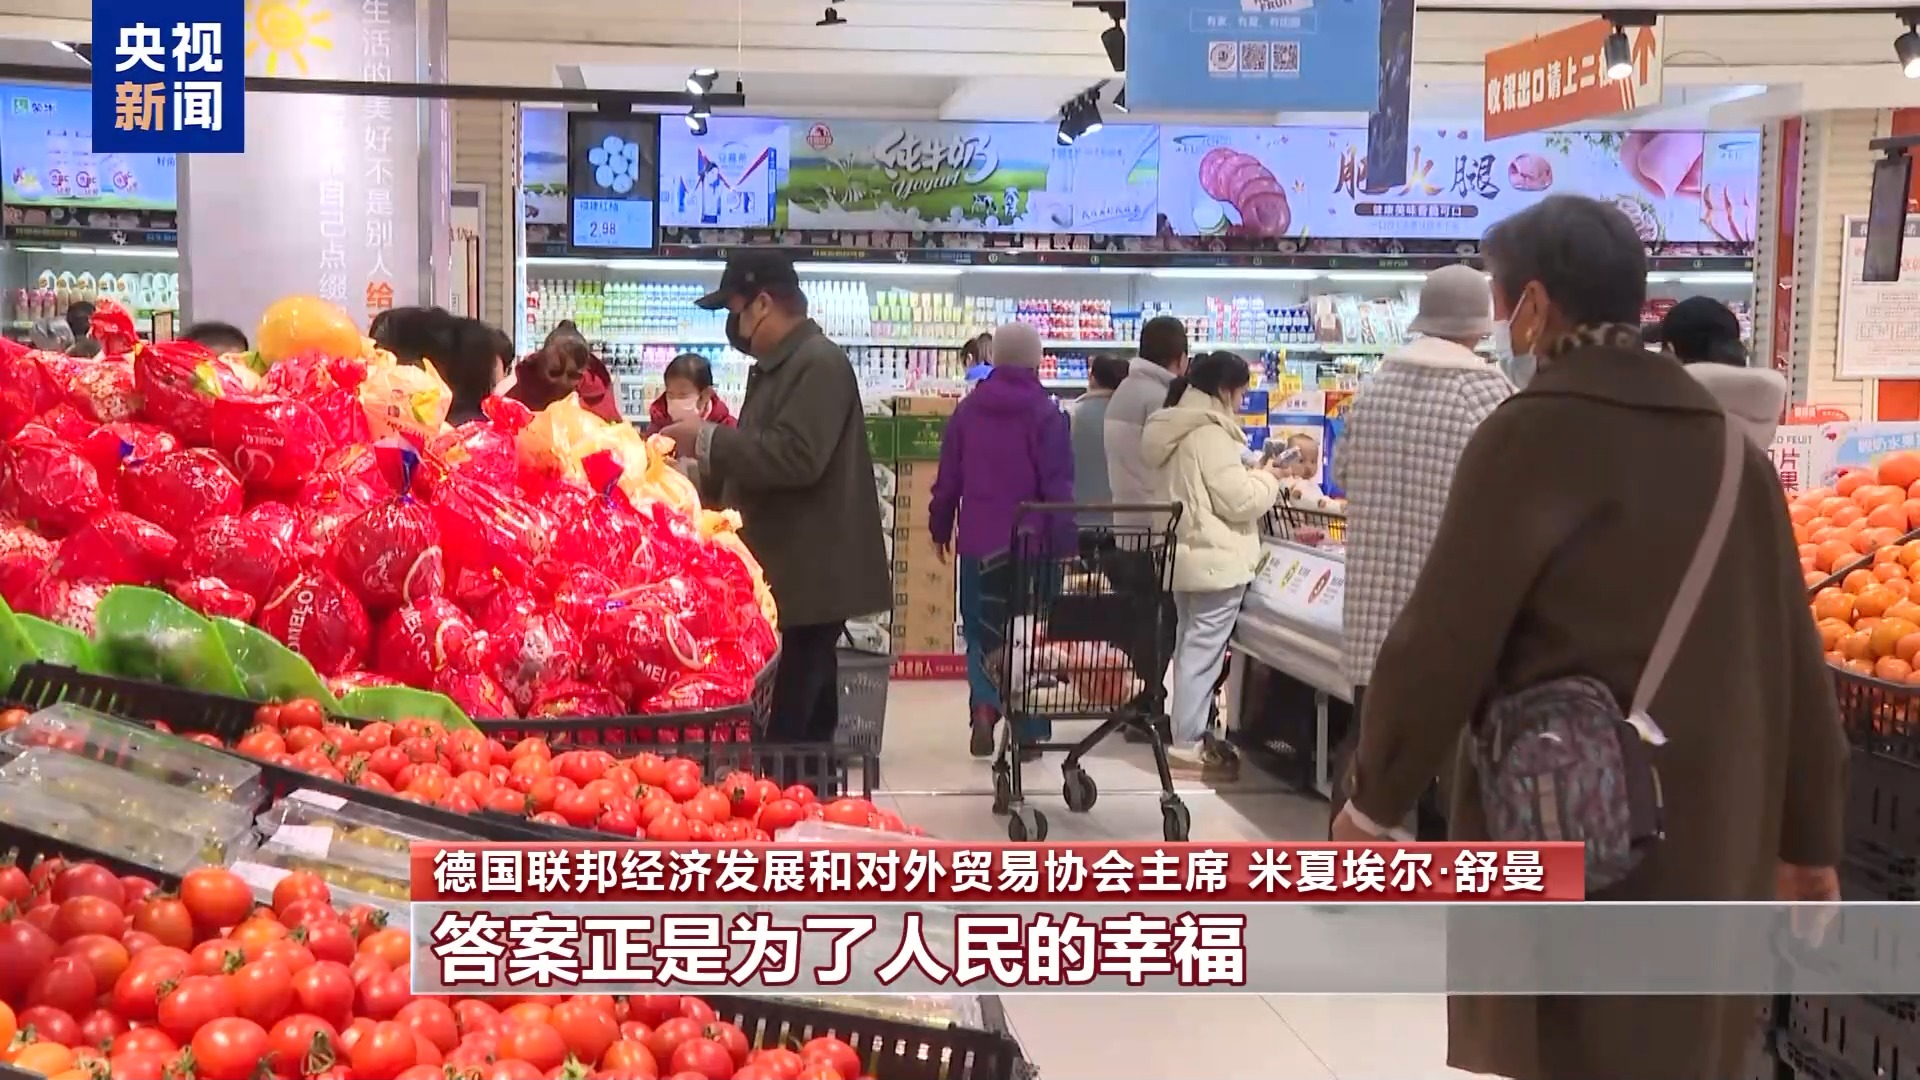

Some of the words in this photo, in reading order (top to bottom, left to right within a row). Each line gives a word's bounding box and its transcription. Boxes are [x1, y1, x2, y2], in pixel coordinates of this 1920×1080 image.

[362, 0, 394, 330] 生活的美好不是别人给
[590, 221, 616, 237] 2.98
[319, 179, 348, 319] 自己点缀
